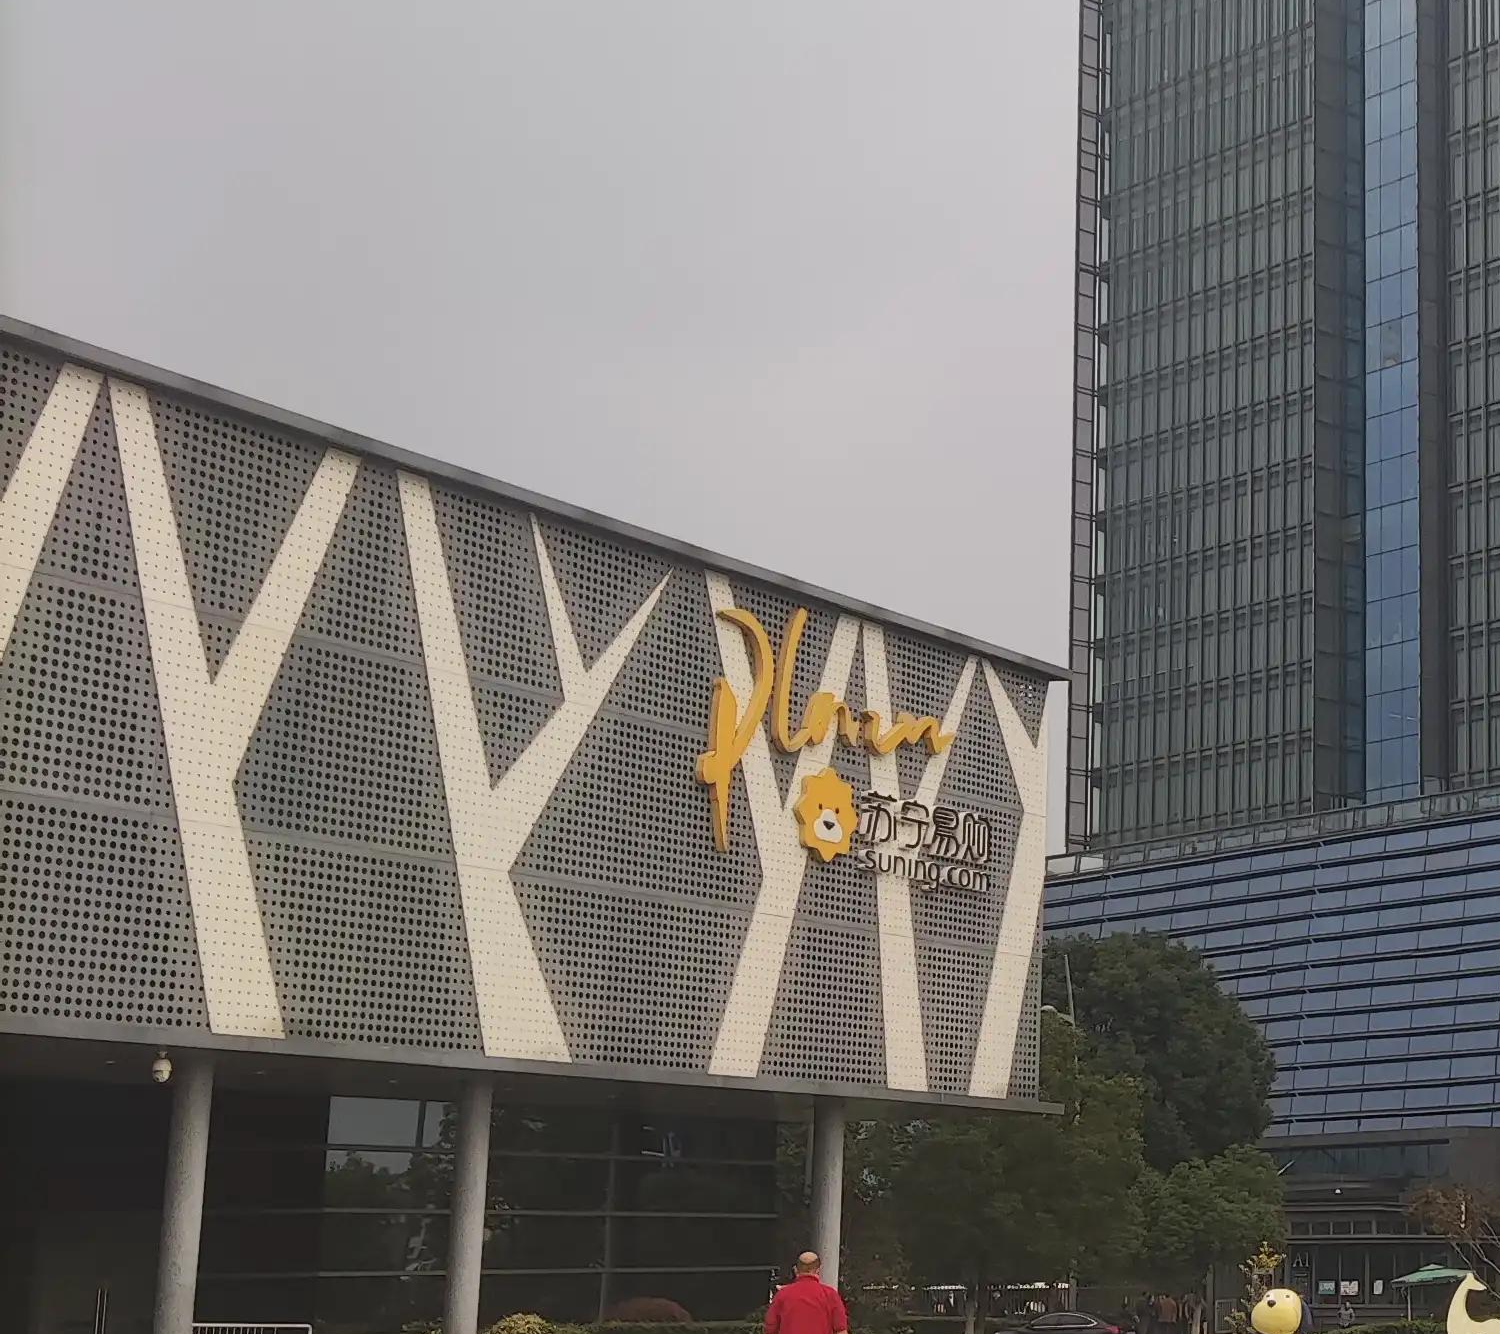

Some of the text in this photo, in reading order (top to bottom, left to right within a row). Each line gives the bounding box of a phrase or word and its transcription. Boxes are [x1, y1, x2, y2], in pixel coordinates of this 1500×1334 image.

[859, 790, 992, 863] 苏宁易购
[860, 850, 990, 892] suning.com
